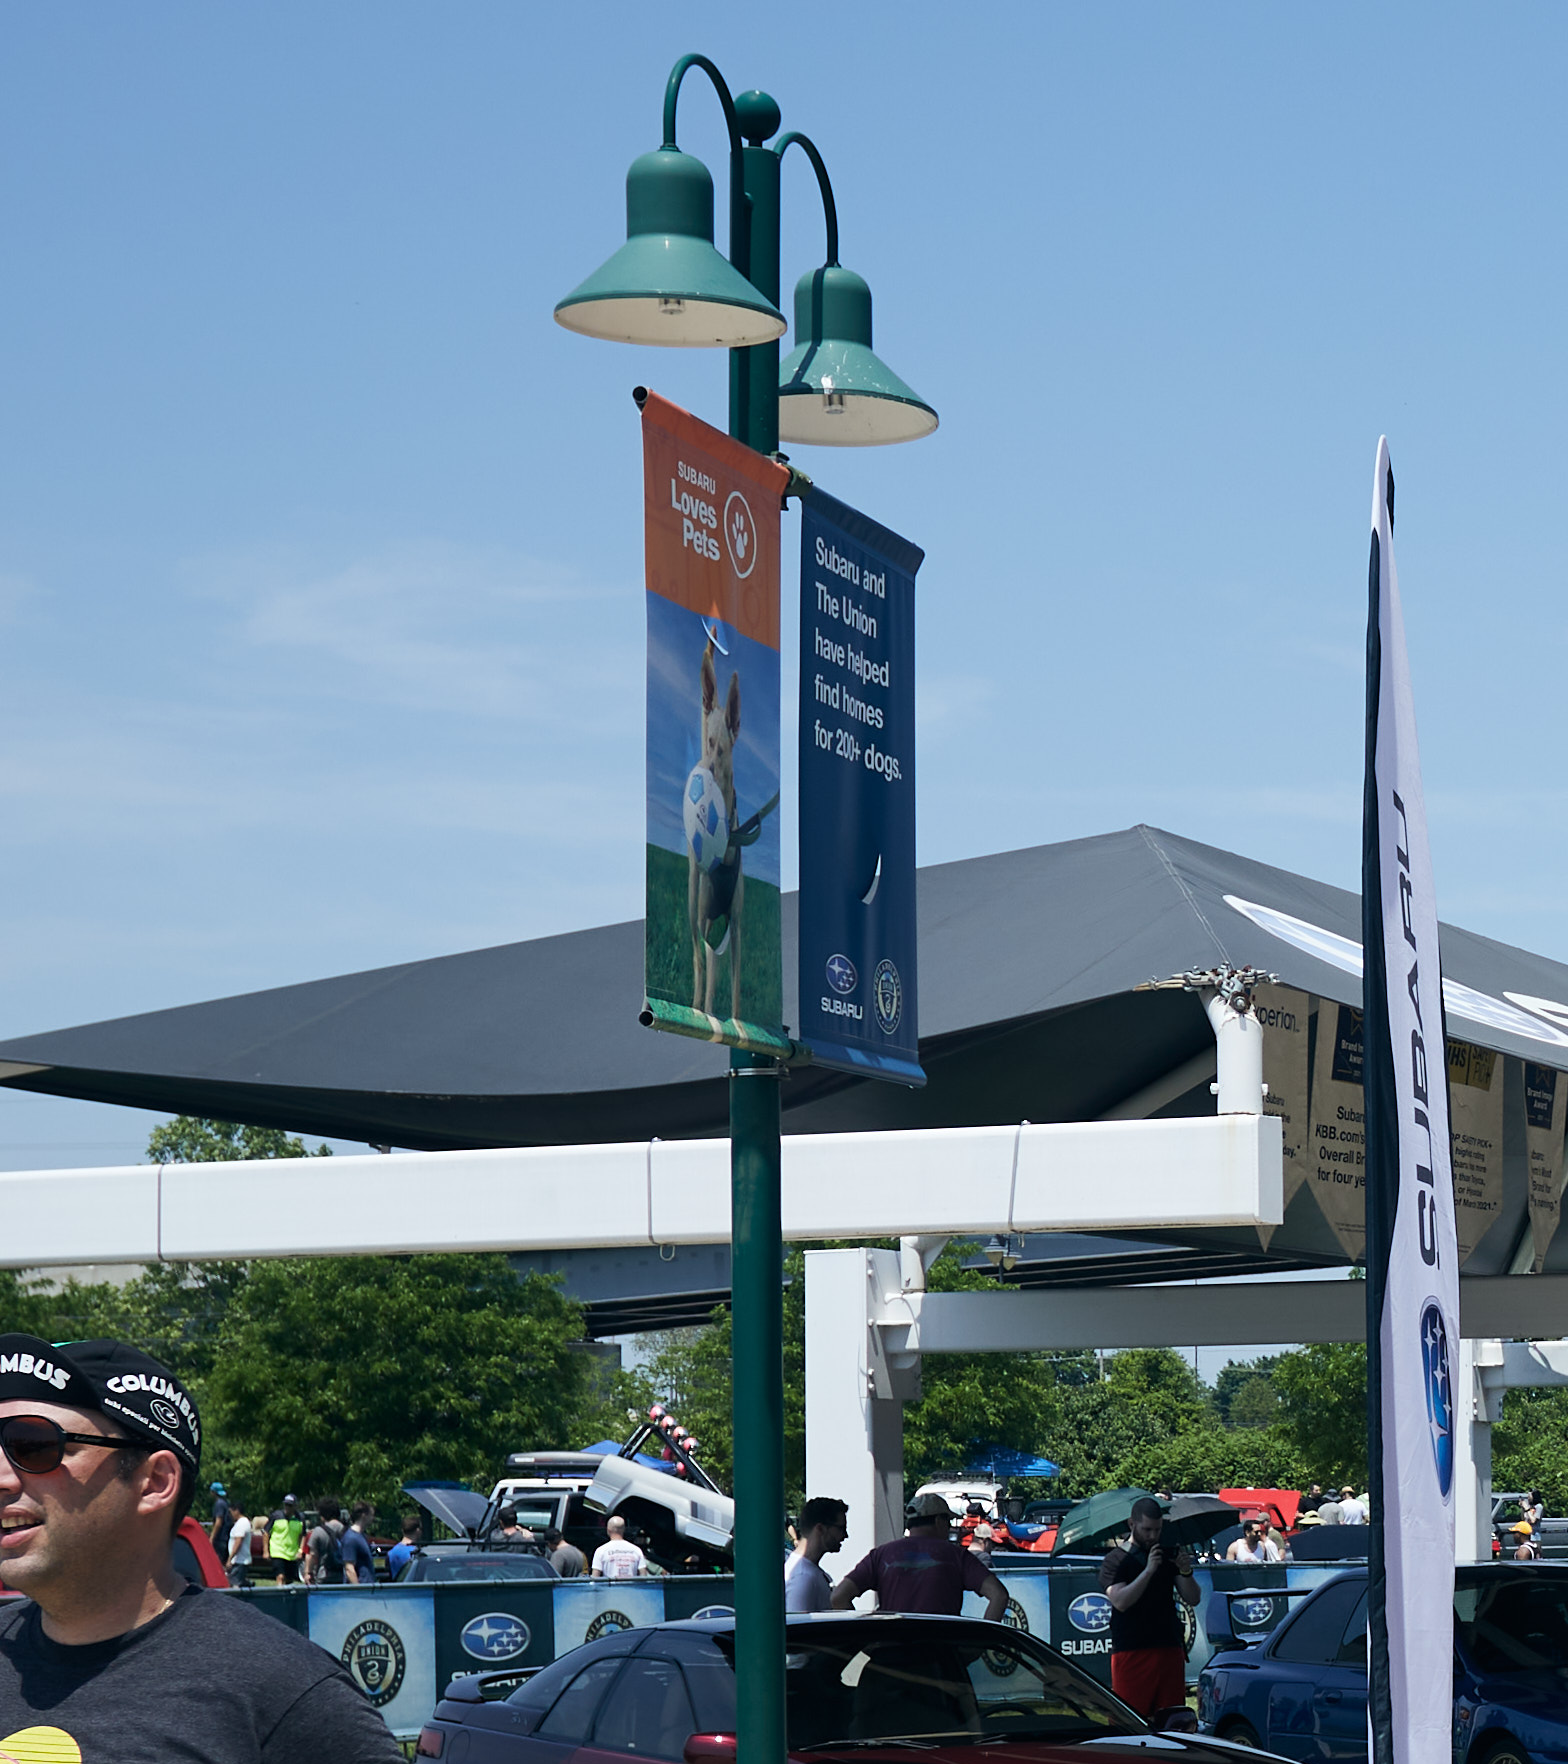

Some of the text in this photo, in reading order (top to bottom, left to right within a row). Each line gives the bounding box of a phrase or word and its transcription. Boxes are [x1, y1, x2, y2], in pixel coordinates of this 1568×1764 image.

[677, 461, 716, 495] SUBARU
[671, 478, 718, 529] Loves
[683, 518, 720, 561] Pets
[815, 537, 886, 599] Subaru and
[815, 581, 877, 639] The Union
[815, 627, 890, 687] have helped
[815, 674, 884, 729] find homes
[815, 719, 902, 782] for 200+ dogs.
[820, 997, 863, 1020] SUBARU
[1255, 1002, 1298, 1033] xperian
[1392, 788, 1440, 1268] SUBARU
[1317, 1167, 1330, 1182] for
[1332, 1167, 1353, 1185] four
[1319, 1145, 1354, 1164] Overall
[106, 1373, 199, 1446] COLUMBUS
[342, 1621, 404, 1664] PHILADELPHIA
[360, 1646, 386, 1657] UNION
[1061, 1639, 1113, 1656] SUBAR
